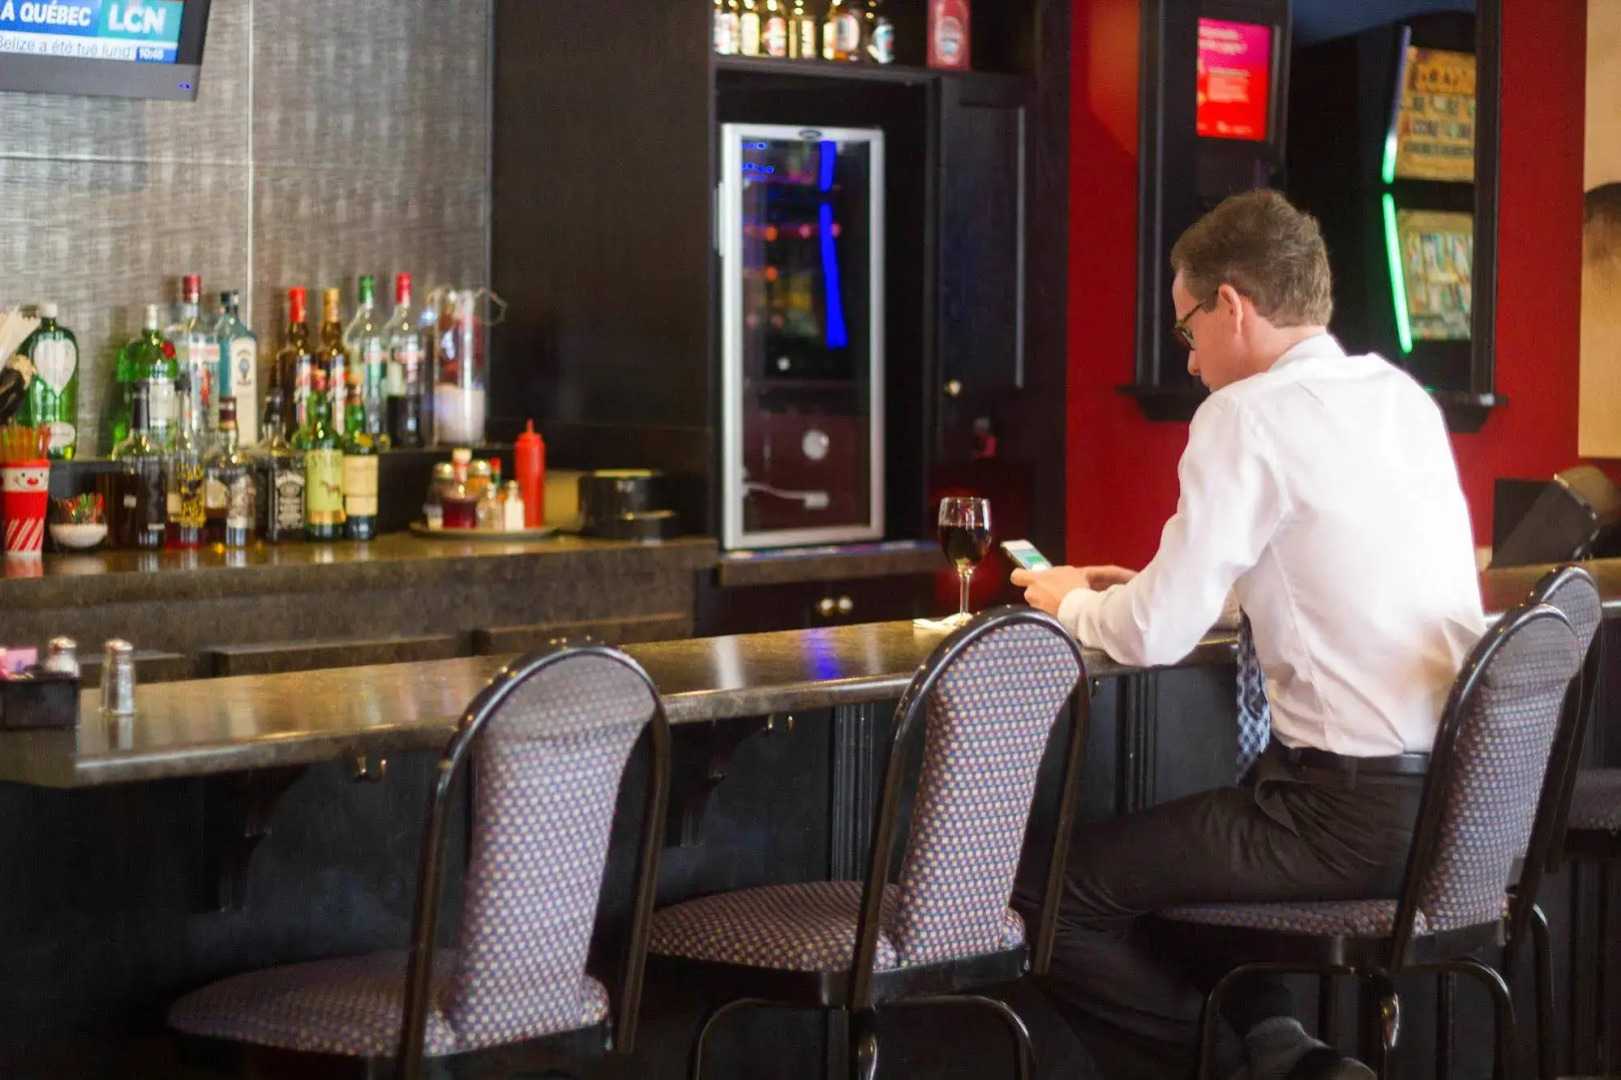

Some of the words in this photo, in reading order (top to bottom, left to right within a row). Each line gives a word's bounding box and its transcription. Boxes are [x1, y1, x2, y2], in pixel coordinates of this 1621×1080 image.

[20, 1, 91, 27] QUÉBEC
[109, 4, 166, 35] LCN
[39, 42, 47, 53] a
